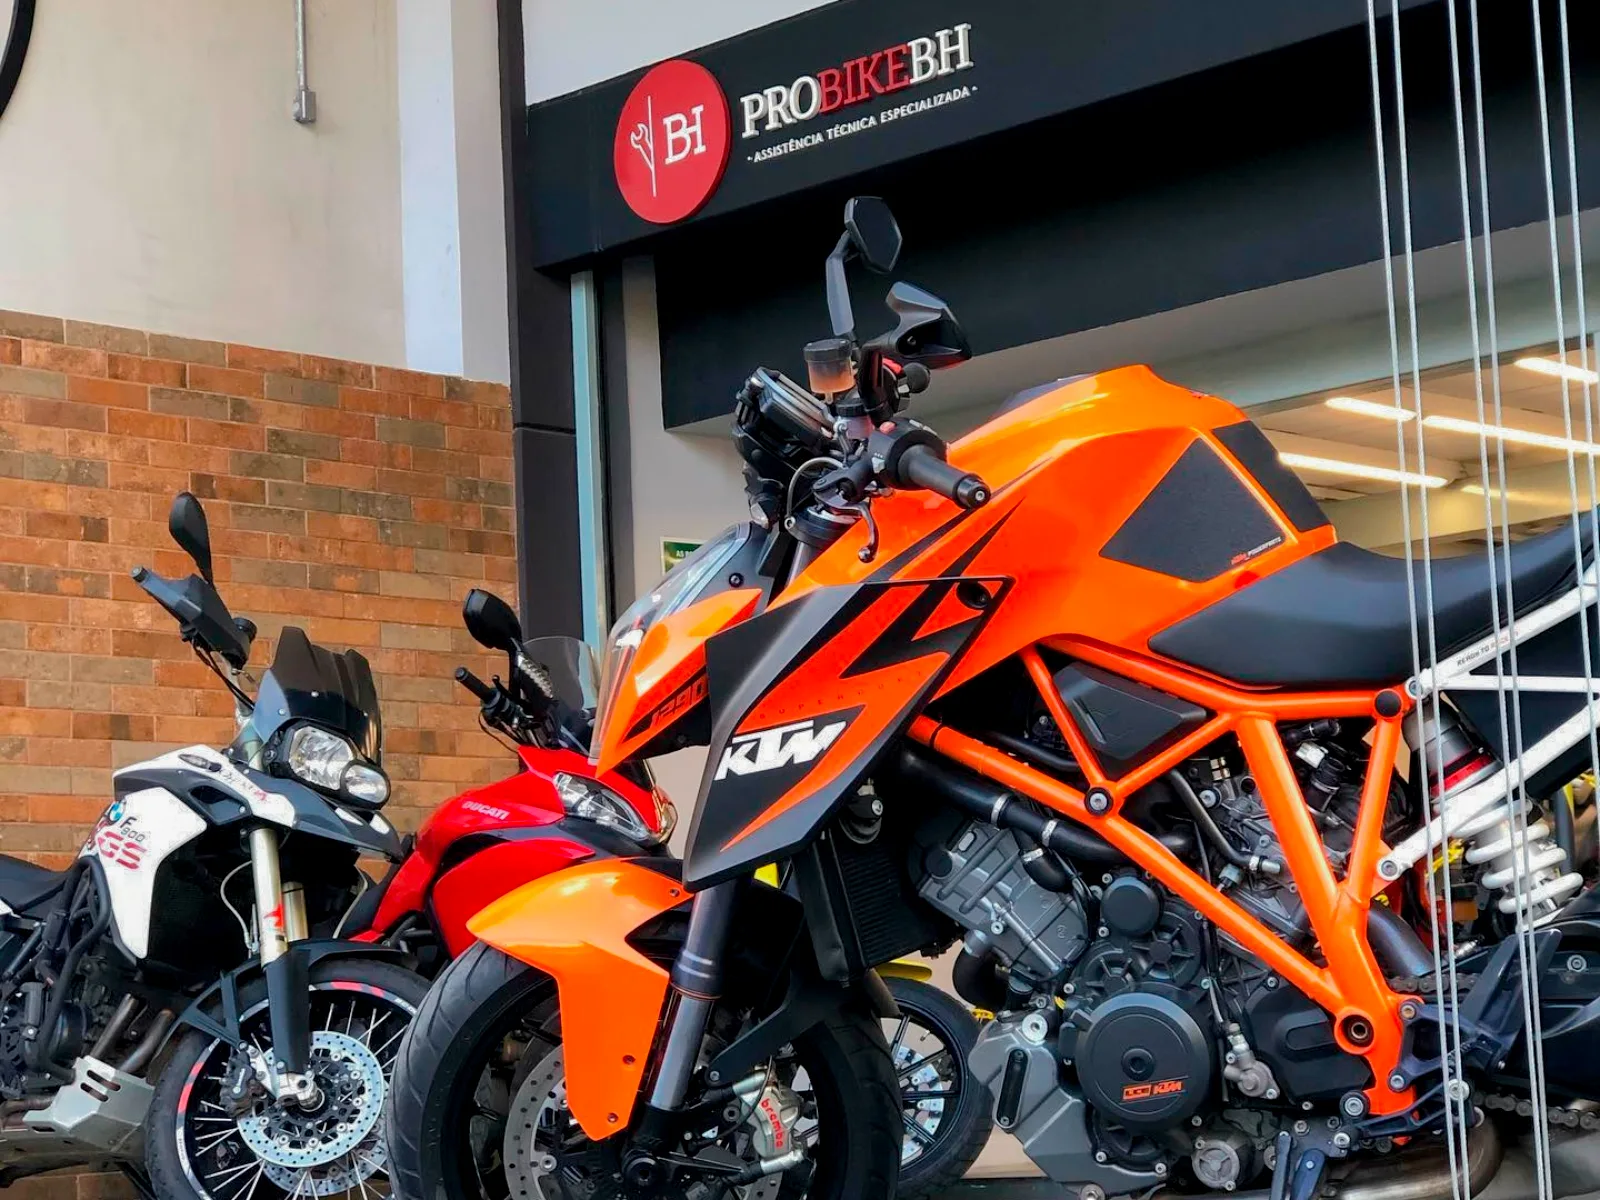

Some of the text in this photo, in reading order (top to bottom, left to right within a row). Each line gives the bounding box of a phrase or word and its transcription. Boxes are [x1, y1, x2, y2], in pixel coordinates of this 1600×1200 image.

[740, 23, 974, 138] PROBIKEBH
[753, 87, 971, 163] ASSISTÊNCIA TÉCNICA ESPECIALIZADA
[713, 719, 847, 781] KTM
[120, 816, 138, 829] F
[461, 801, 510, 820] DUCATI
[97, 831, 147, 870] GS
[761, 1098, 784, 1149] brembo
